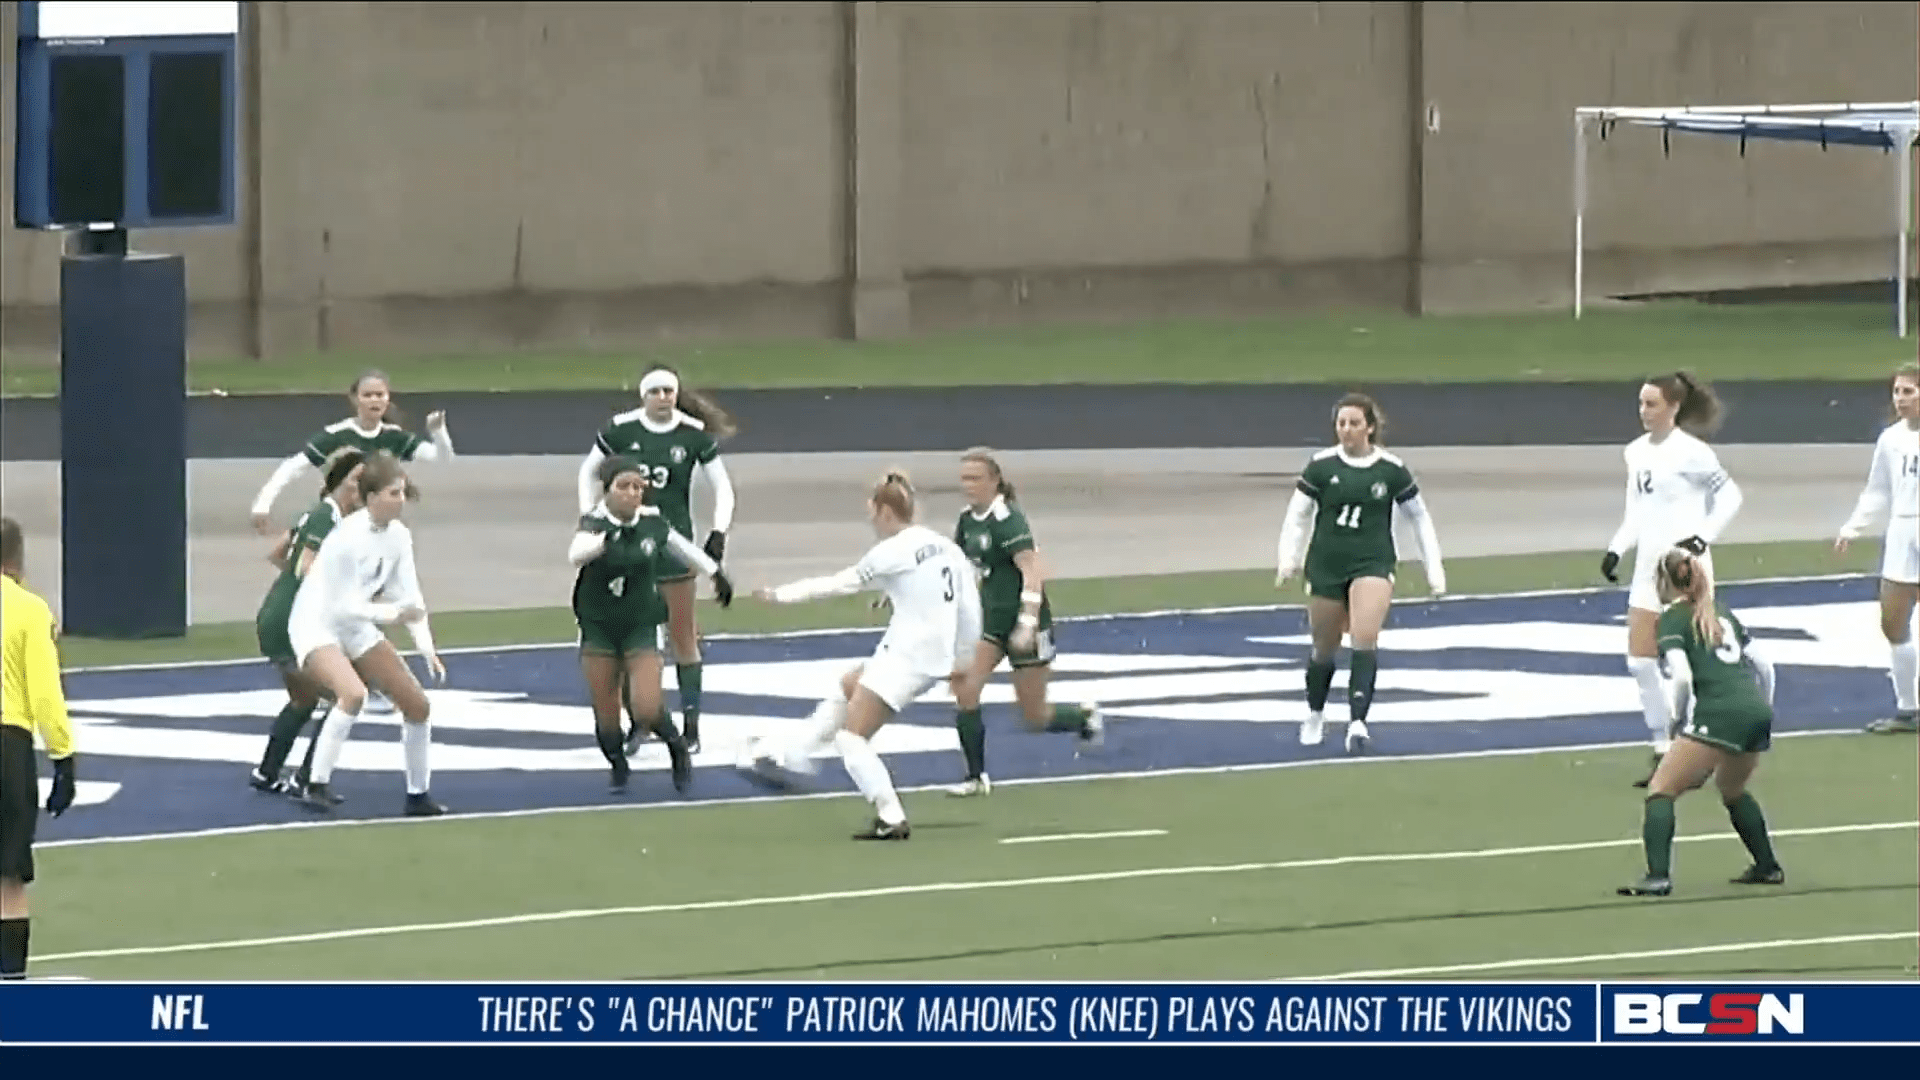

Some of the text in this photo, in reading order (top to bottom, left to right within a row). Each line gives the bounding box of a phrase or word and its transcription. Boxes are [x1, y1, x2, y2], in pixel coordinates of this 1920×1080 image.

[1902, 454, 1918, 478] 14
[1636, 469, 1654, 495] 12
[1336, 504, 1362, 529] 11
[608, 576, 626, 598] 4
[941, 566, 954, 602] 3
